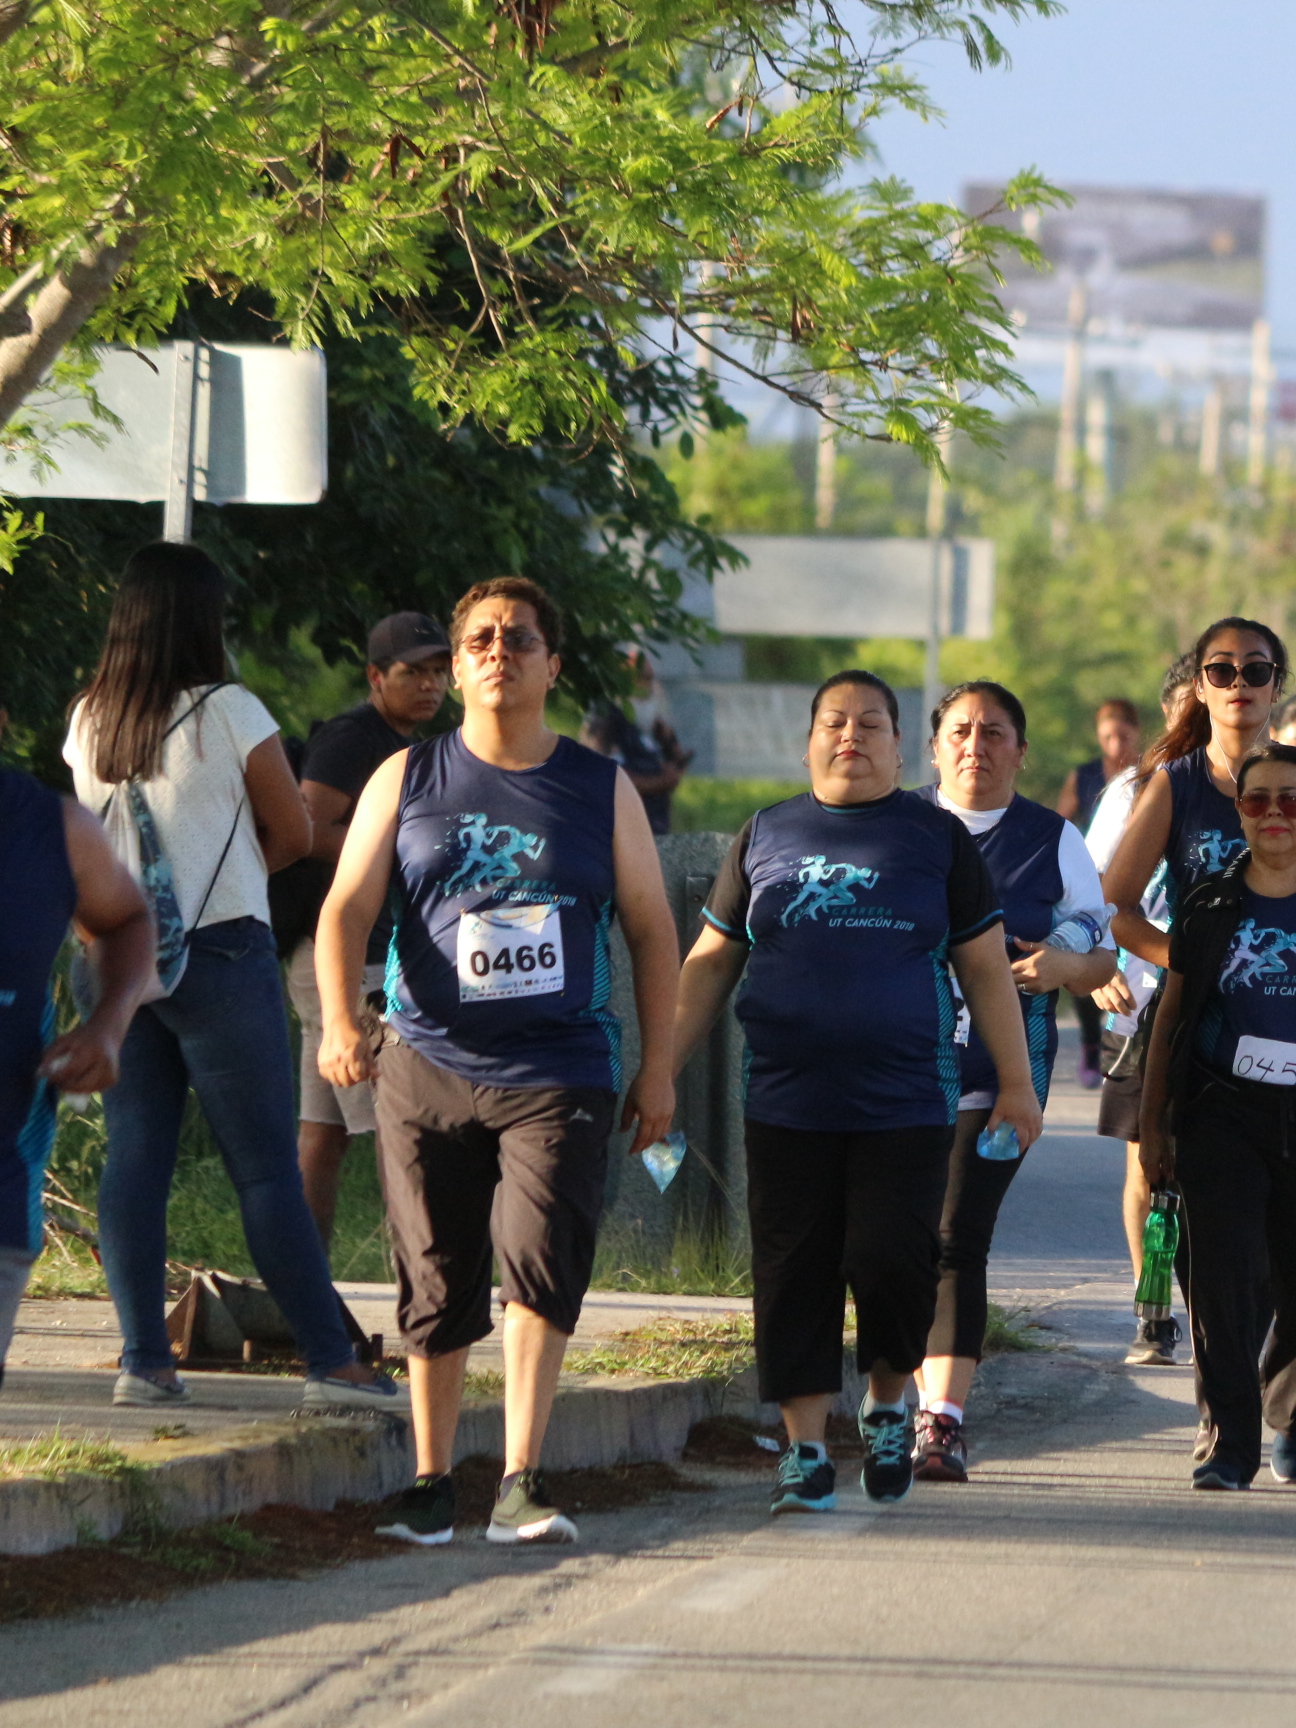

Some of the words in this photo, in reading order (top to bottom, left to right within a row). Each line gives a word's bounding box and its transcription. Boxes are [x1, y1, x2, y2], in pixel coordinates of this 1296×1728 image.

[492, 889, 506, 900] UT
[832, 906, 893, 916] CARRERA
[829, 918, 843, 928] UT
[845, 916, 892, 928] CANCÚN
[470, 943, 557, 977] 0466
[1264, 986, 1276, 996] UT
